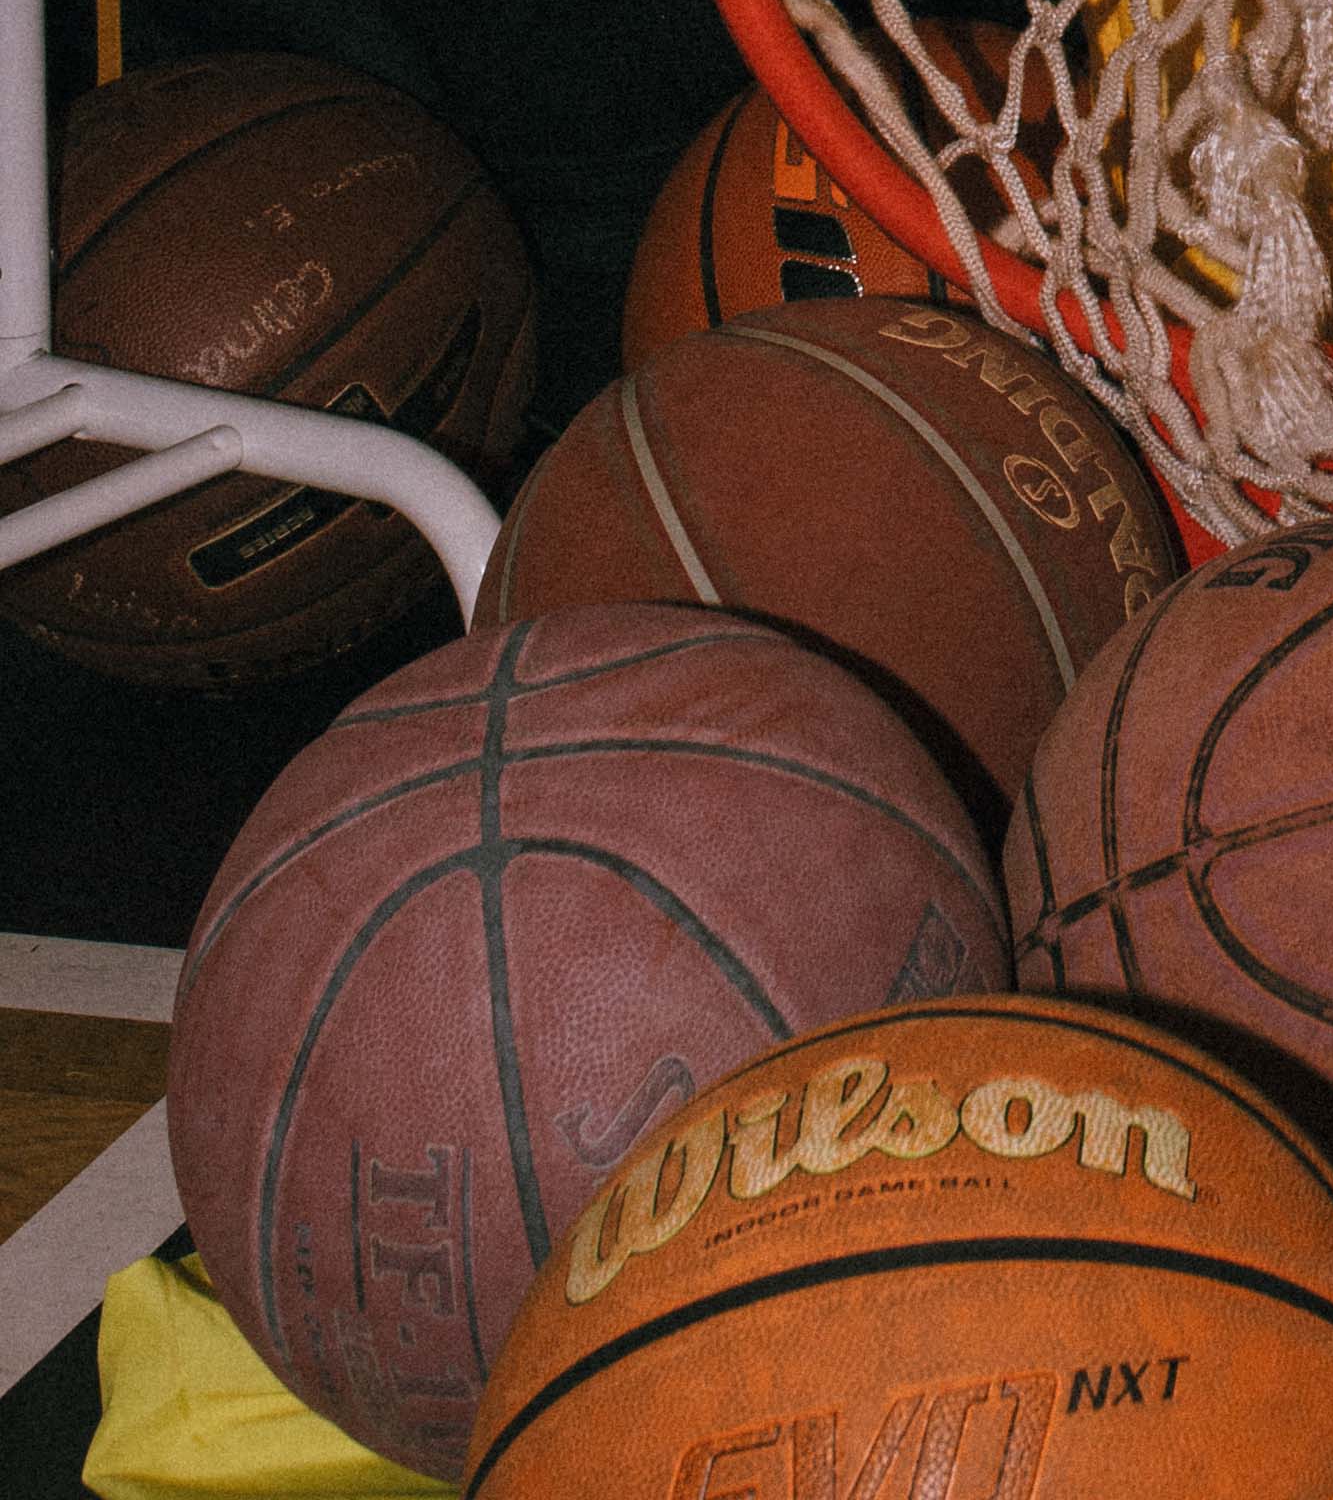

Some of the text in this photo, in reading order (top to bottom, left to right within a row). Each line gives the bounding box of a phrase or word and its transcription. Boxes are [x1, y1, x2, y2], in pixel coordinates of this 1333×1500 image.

[565, 1056, 1198, 1306] Wilson
[703, 1174, 1013, 1250] INDOOR GAME BALL
[1066, 1355, 1188, 1415] NXT
